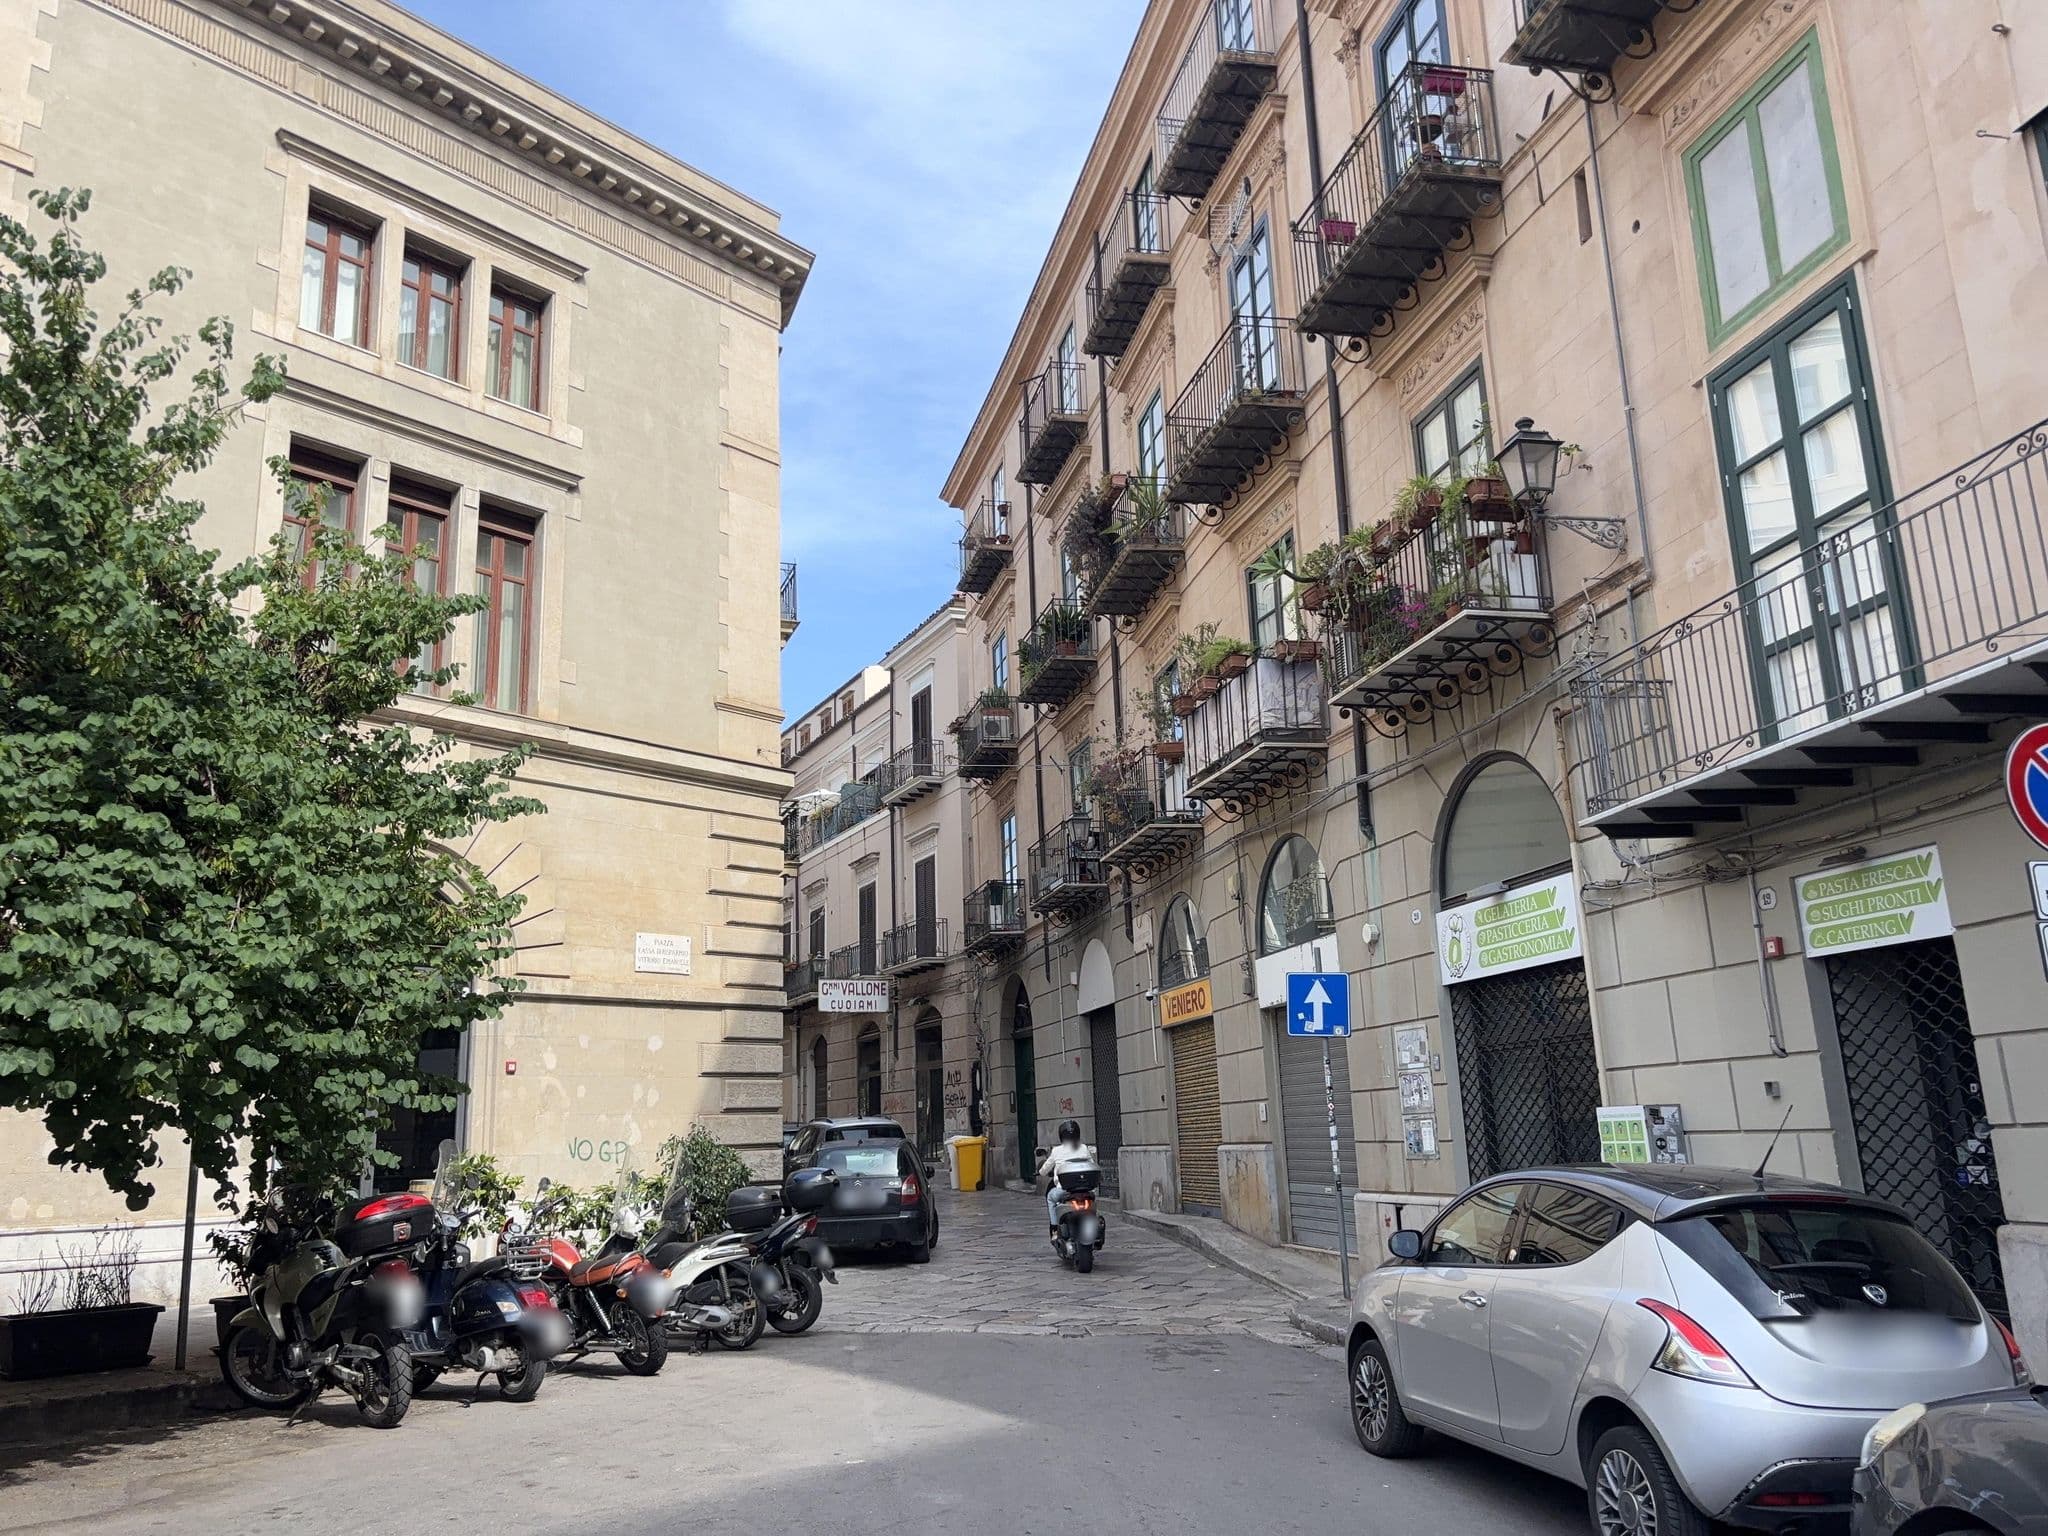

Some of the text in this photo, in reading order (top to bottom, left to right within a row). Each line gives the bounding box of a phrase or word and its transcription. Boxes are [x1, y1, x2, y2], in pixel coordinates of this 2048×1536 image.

[1818, 863, 1916, 897] PASTA FRESCA
[1484, 896, 1538, 923] GELATERIA
[1821, 887, 1922, 921] SUGHI PRONTI
[654, 939, 674, 947] PIAZZA
[1486, 916, 1549, 944] PASTICCERIA
[1826, 919, 1898, 945] CATERING
[1488, 934, 1565, 963] GASTRONOMIA
[841, 982, 887, 996] VALLONE
[830, 1000, 877, 1010] CUOIAMI
[1164, 987, 1206, 1019] VENIERO
